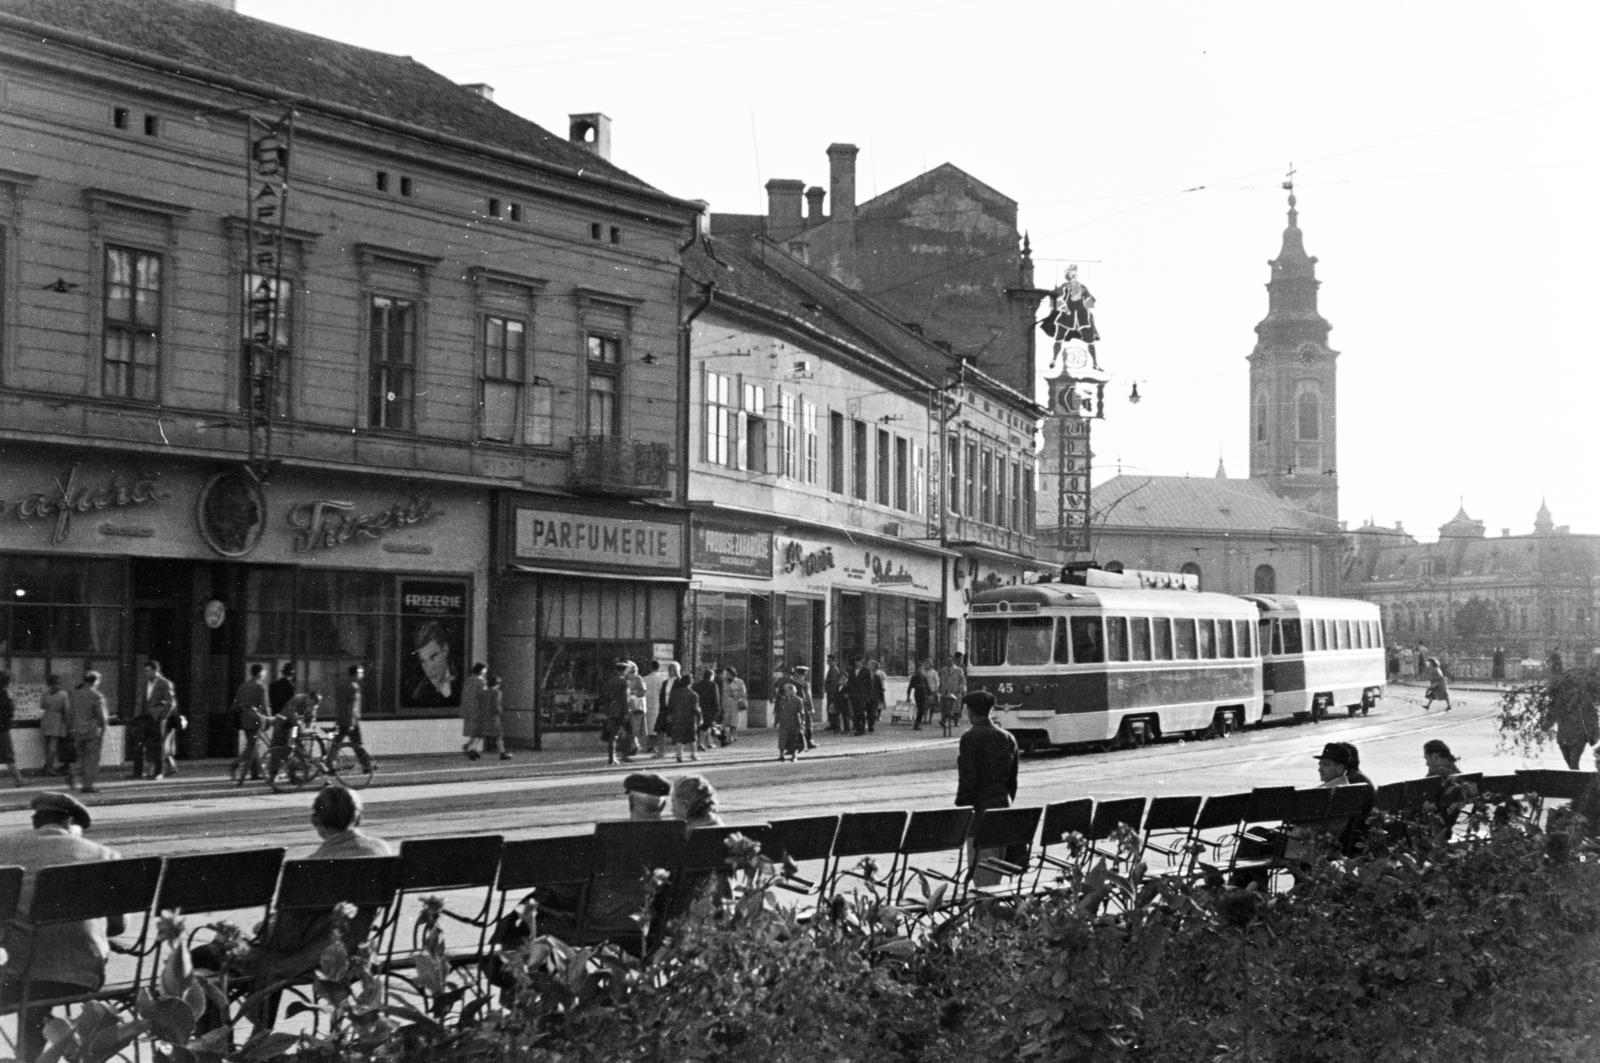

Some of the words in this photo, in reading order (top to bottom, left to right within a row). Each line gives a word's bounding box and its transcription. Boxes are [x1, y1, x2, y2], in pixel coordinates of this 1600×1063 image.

[1058, 384, 1092, 545] GULLIVER
[533, 519, 667, 557] PARFUMERIE
[405, 593, 461, 608] FRIZERIE
[997, 682, 1013, 693] 45
